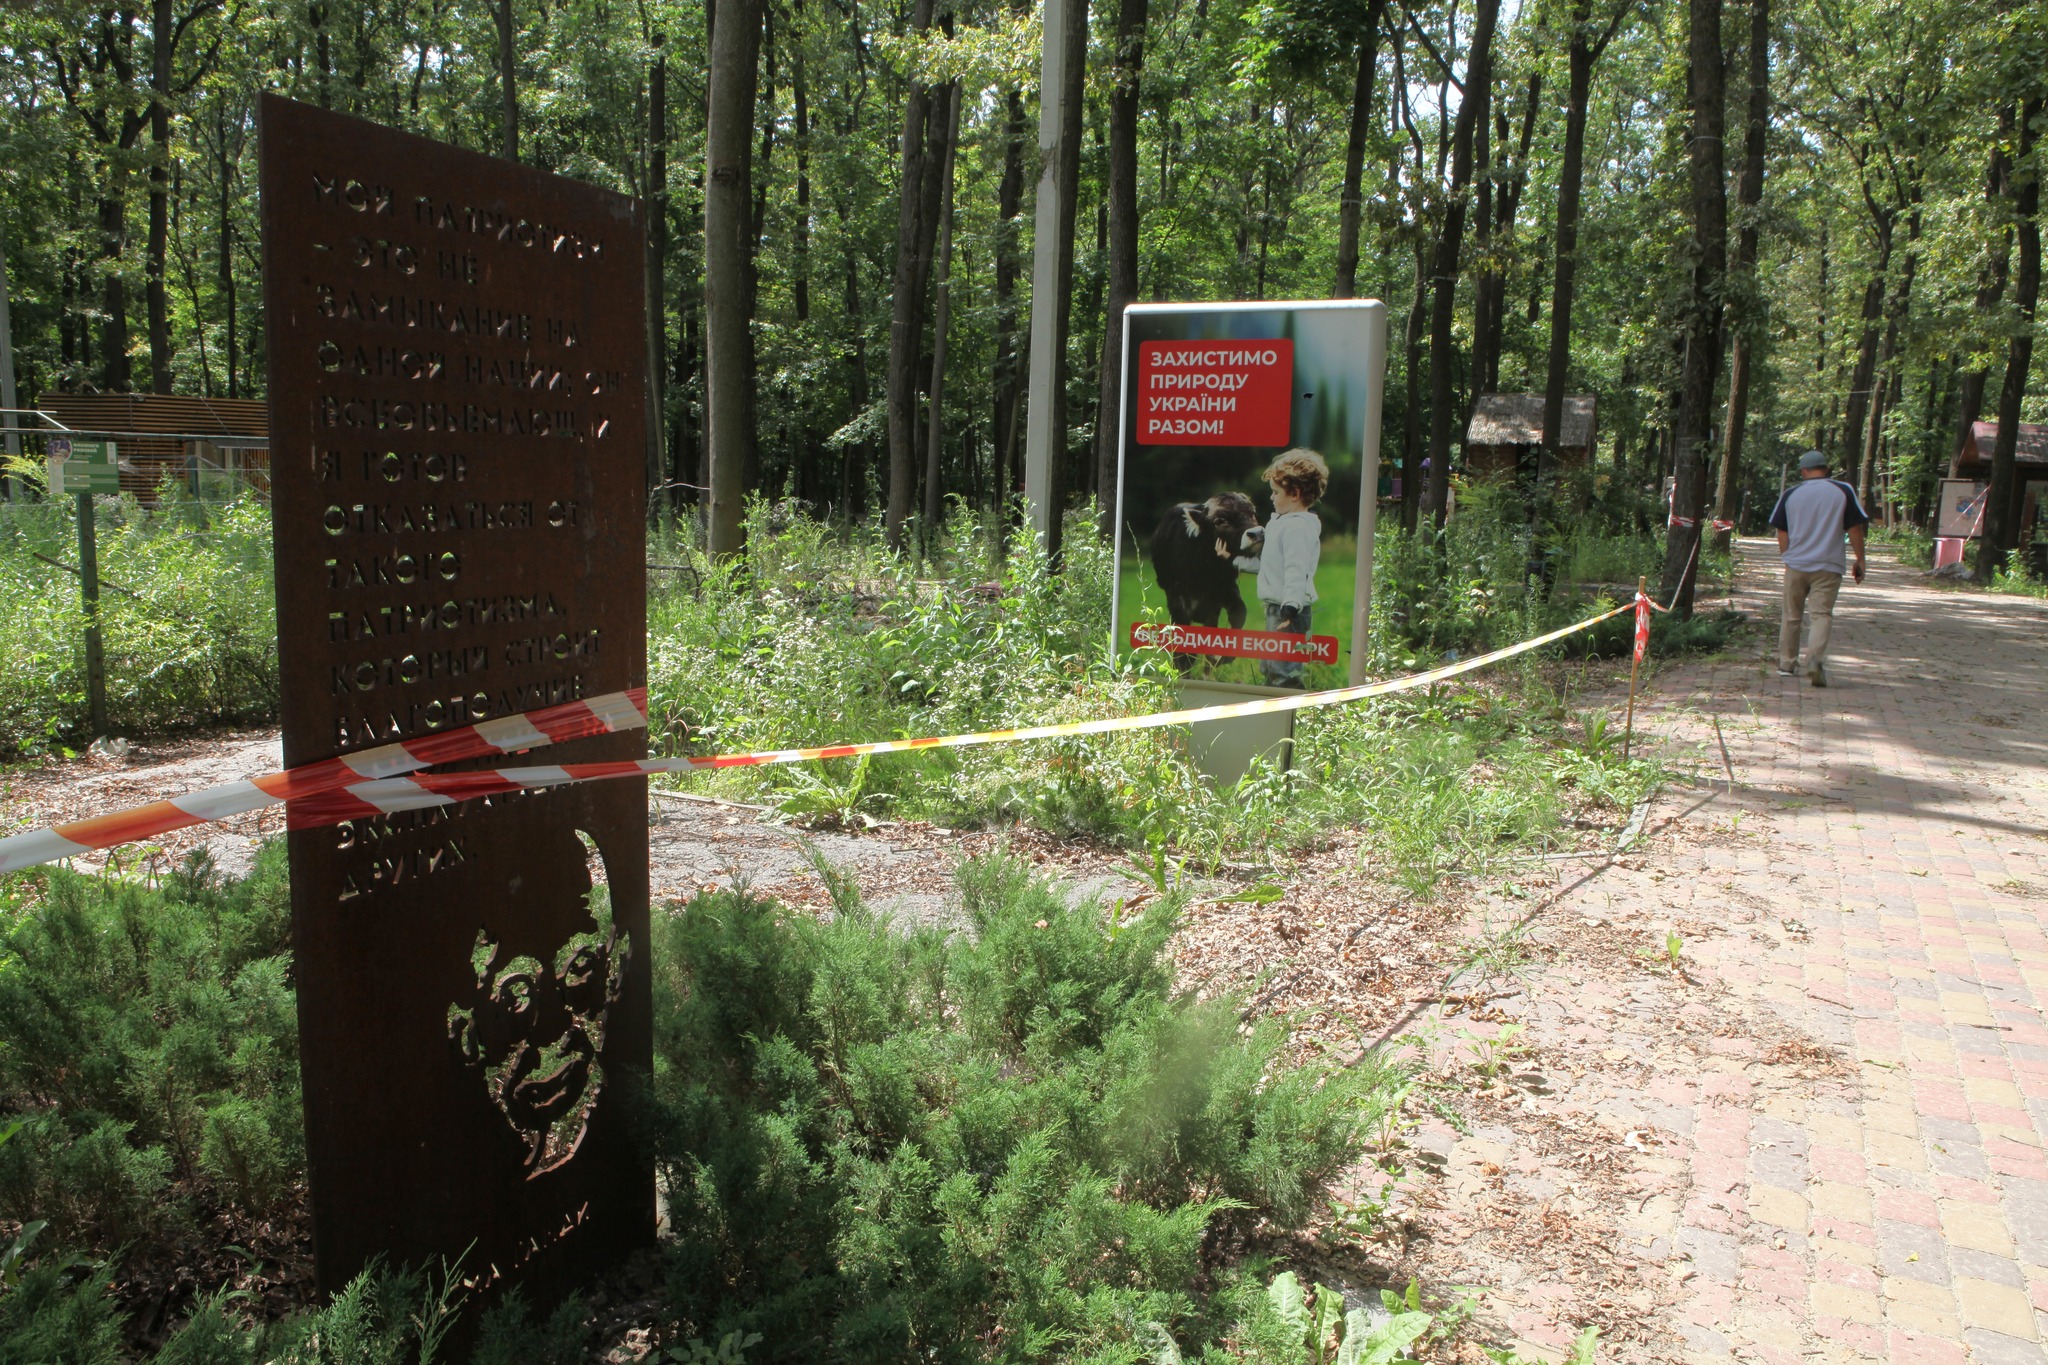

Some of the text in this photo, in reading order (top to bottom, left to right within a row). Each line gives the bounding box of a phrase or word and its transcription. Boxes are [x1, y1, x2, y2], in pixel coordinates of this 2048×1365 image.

[415, 195, 605, 260] ПАТРИОТИЗМ
[437, 250, 478, 286] НЕ
[316, 284, 583, 348] ЗАМЫКАНИЕ НА
[1151, 350, 1277, 367] ЗАХИСТИМО
[1150, 373, 1249, 391] ПРИРОДУ
[1149, 393, 1236, 412] УКРАЇНИ
[596, 413, 612, 440] И
[1148, 418, 1224, 435] РАЗОМ!
[321, 450, 468, 483] Я ГОТОВ
[323, 500, 579, 537] ОТКАЗАТЬСЯ ОТ
[324, 550, 462, 590] ТАКОГО
[330, 627, 601, 697] КОТОРЫЙ СТРОИТ
[334, 674, 585, 750] БЛАГОПОЛУЧИЕ
